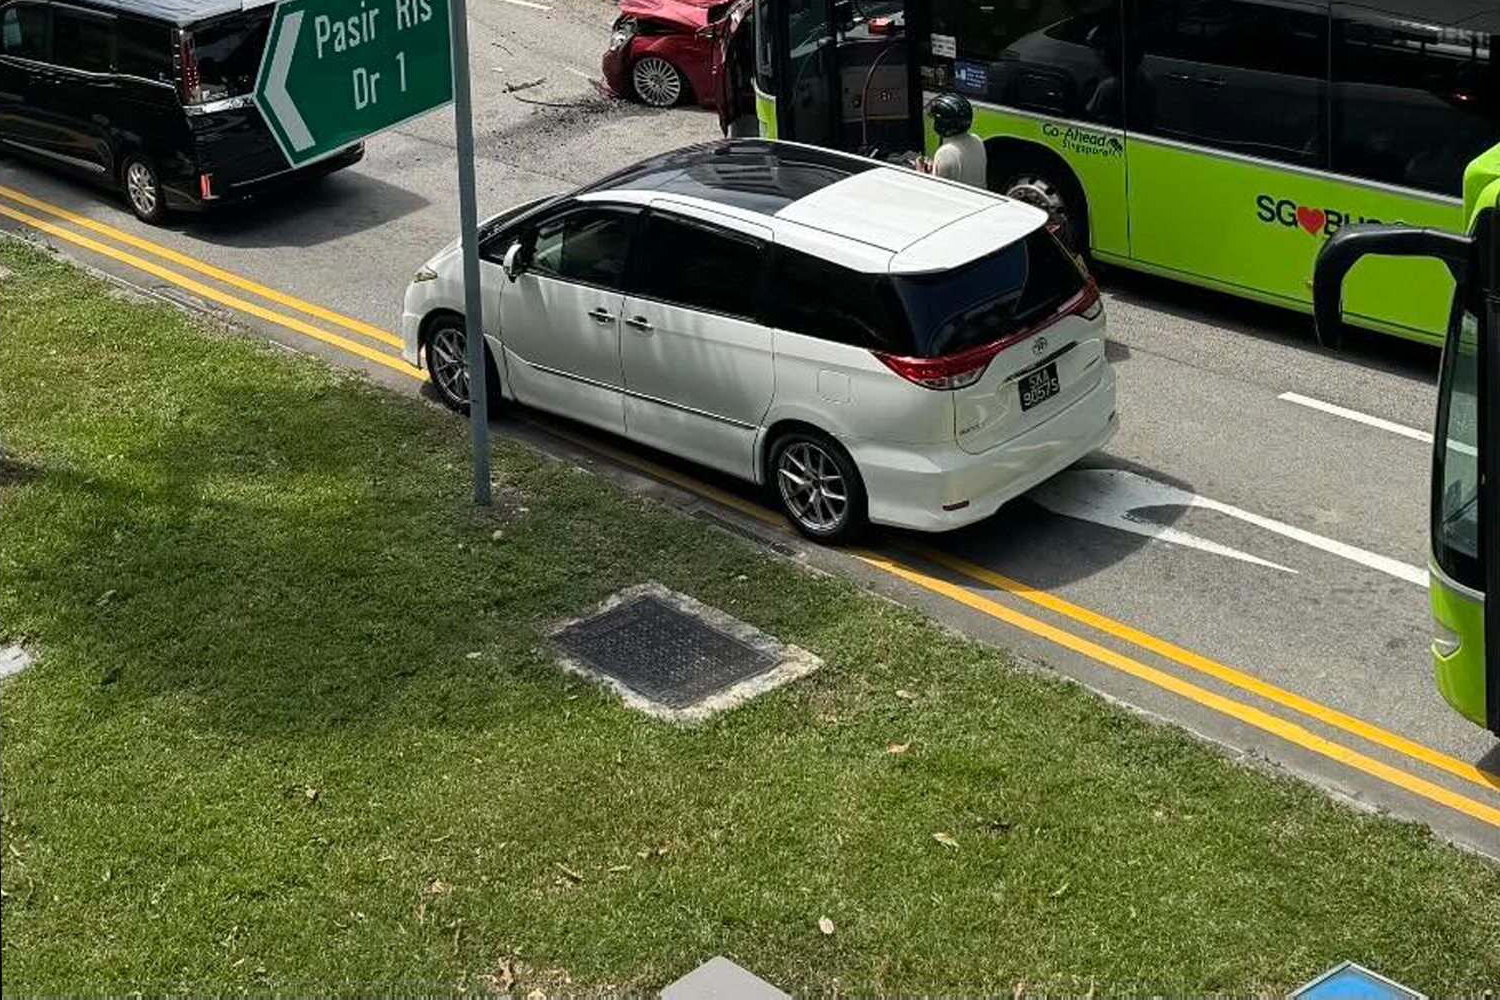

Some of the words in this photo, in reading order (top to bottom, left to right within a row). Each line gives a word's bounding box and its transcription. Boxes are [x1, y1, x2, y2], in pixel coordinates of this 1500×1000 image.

[314, 0, 379, 59] Pasir
[353, 67, 380, 110] Dr
[396, 51, 407, 92] 1
